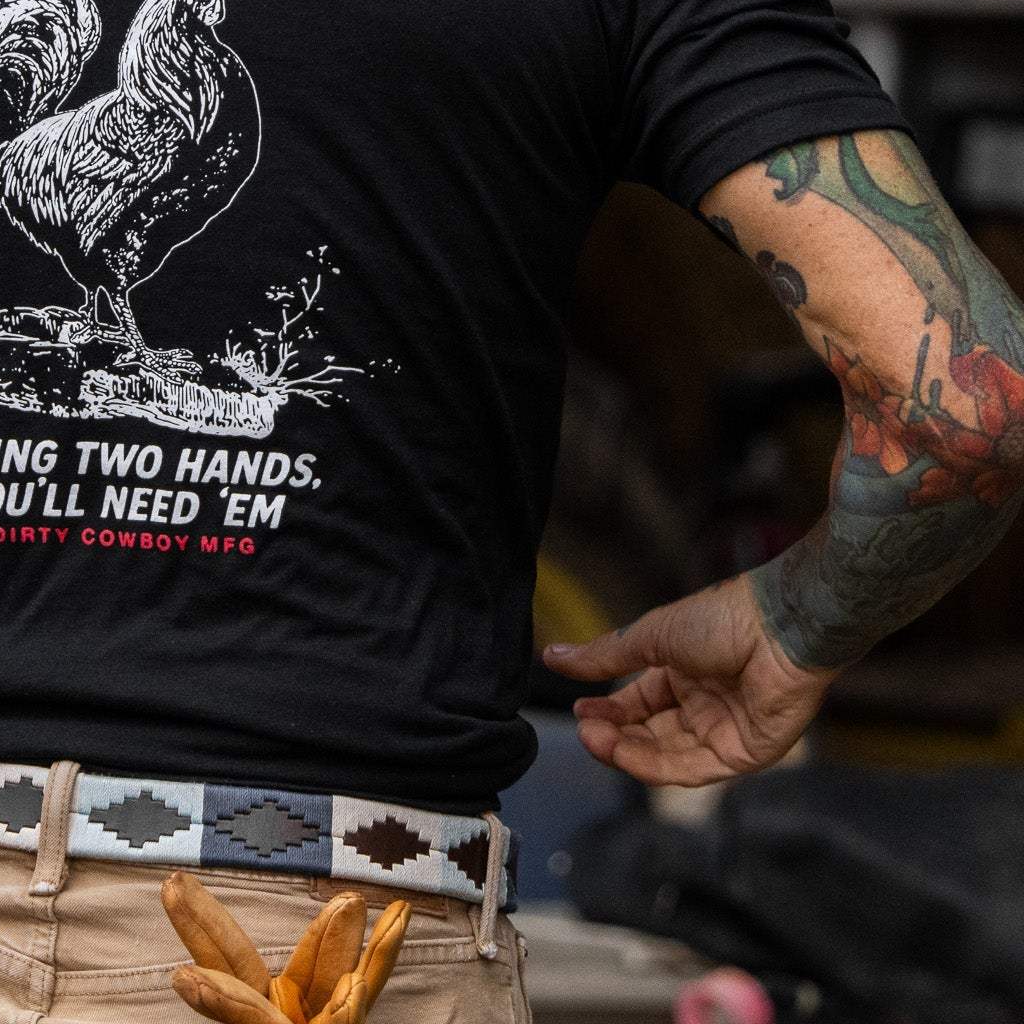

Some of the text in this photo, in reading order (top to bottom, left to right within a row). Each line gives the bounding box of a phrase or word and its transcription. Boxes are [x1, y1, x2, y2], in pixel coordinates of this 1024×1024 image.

[75, 441, 164, 479] TWO
[174, 447, 322, 490] HANDS,
[99, 484, 200, 525] NEED
[219, 486, 287, 529] 'EM
[80, 527, 189, 552] COWBOY
[200, 535, 256, 555] MFG
